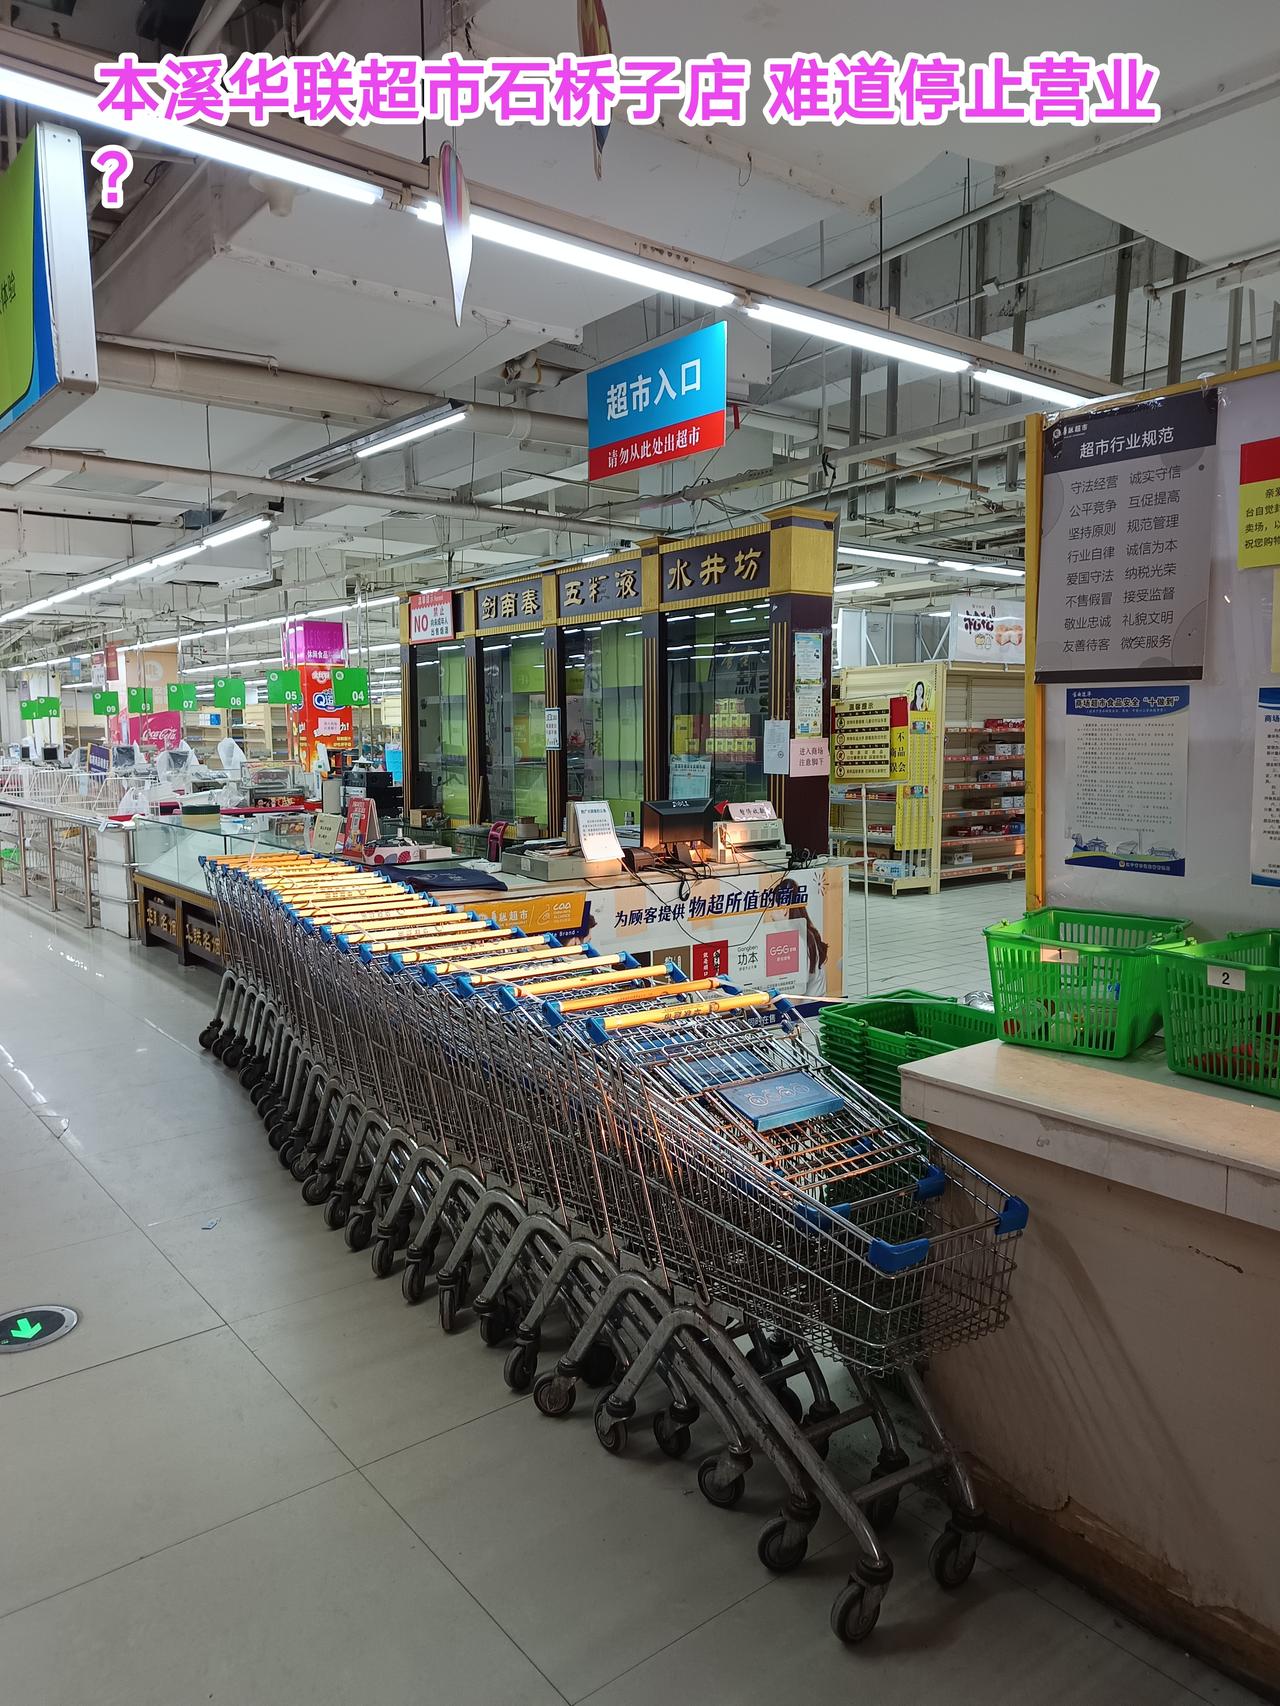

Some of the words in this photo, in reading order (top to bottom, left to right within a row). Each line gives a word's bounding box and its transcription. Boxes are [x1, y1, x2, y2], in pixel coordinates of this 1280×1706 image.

[0, 268, 17, 316] 体验
[606, 358, 701, 421] 超市入口
[607, 426, 701, 468] 请勿从此处出超市
[1079, 426, 1175, 459] 超市行业规范
[1070, 475, 1119, 495] 守法经营
[1129, 465, 1182, 486] 诚实守信
[1069, 499, 1117, 518] 公平竞争
[1128, 489, 1181, 509] 互促提高
[1068, 522, 1116, 541] 坚持原则
[1126, 514, 1180, 534] 规范管理
[1067, 546, 1115, 563] 行业自律
[1126, 538, 1178, 557] 诚信为本
[666, 547, 762, 591] 水井坊
[1066, 569, 1114, 586] 爱国守法
[1124, 563, 1177, 581] 纳税光荣
[481, 588, 541, 621] 剑南春
[1065, 591, 1113, 608] 不售假冒
[1123, 586, 1175, 604] 接受监督
[414, 614, 429, 633] NO
[1064, 615, 1112, 631] 敬业忠诚
[1121, 610, 1174, 627] 礼貌文明
[1063, 638, 1110, 653] 友善待客
[1120, 634, 1172, 650] 微笑服务
[182, 700, 194, 709] 07
[230, 696, 242, 706] 06
[285, 690, 298, 701] 05
[352, 690, 365, 702] 04
[106, 705, 116, 713] 09
[799, 747, 824, 756] 进入商场
[799, 757, 825, 767] 注意脚下
[614, 903, 685, 928] 为顾客提供
[688, 885, 809, 919] 物超所值的商品
[737, 952, 759, 966] 功本
[769, 944, 790, 956] GSG
[1057, 949, 1062, 960] 1
[1222, 972, 1230, 985] 2
